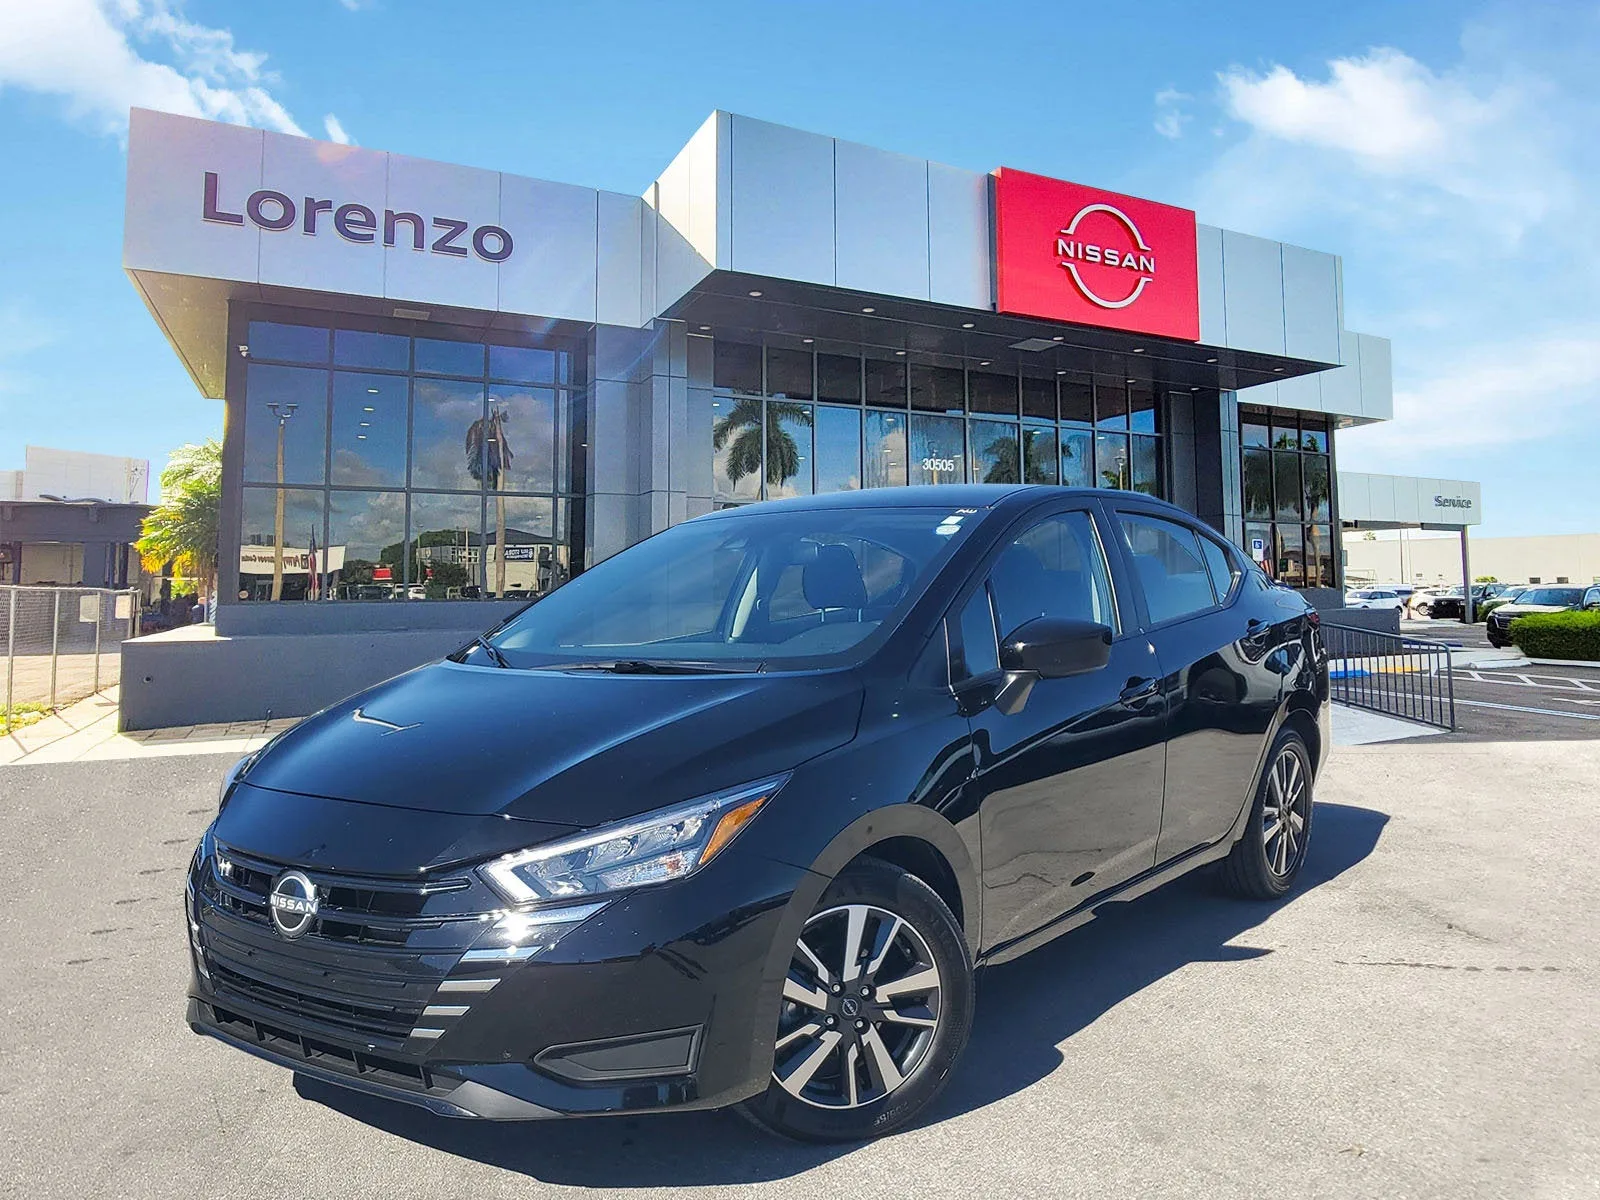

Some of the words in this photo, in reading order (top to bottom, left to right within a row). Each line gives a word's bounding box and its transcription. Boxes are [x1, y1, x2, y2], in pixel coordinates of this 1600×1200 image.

[202, 171, 514, 262] Lorenzo
[1056, 238, 1155, 273] NISSAN
[922, 458, 954, 472] 30505
[1434, 495, 1472, 509] Service
[270, 894, 316, 913] NISSAN
